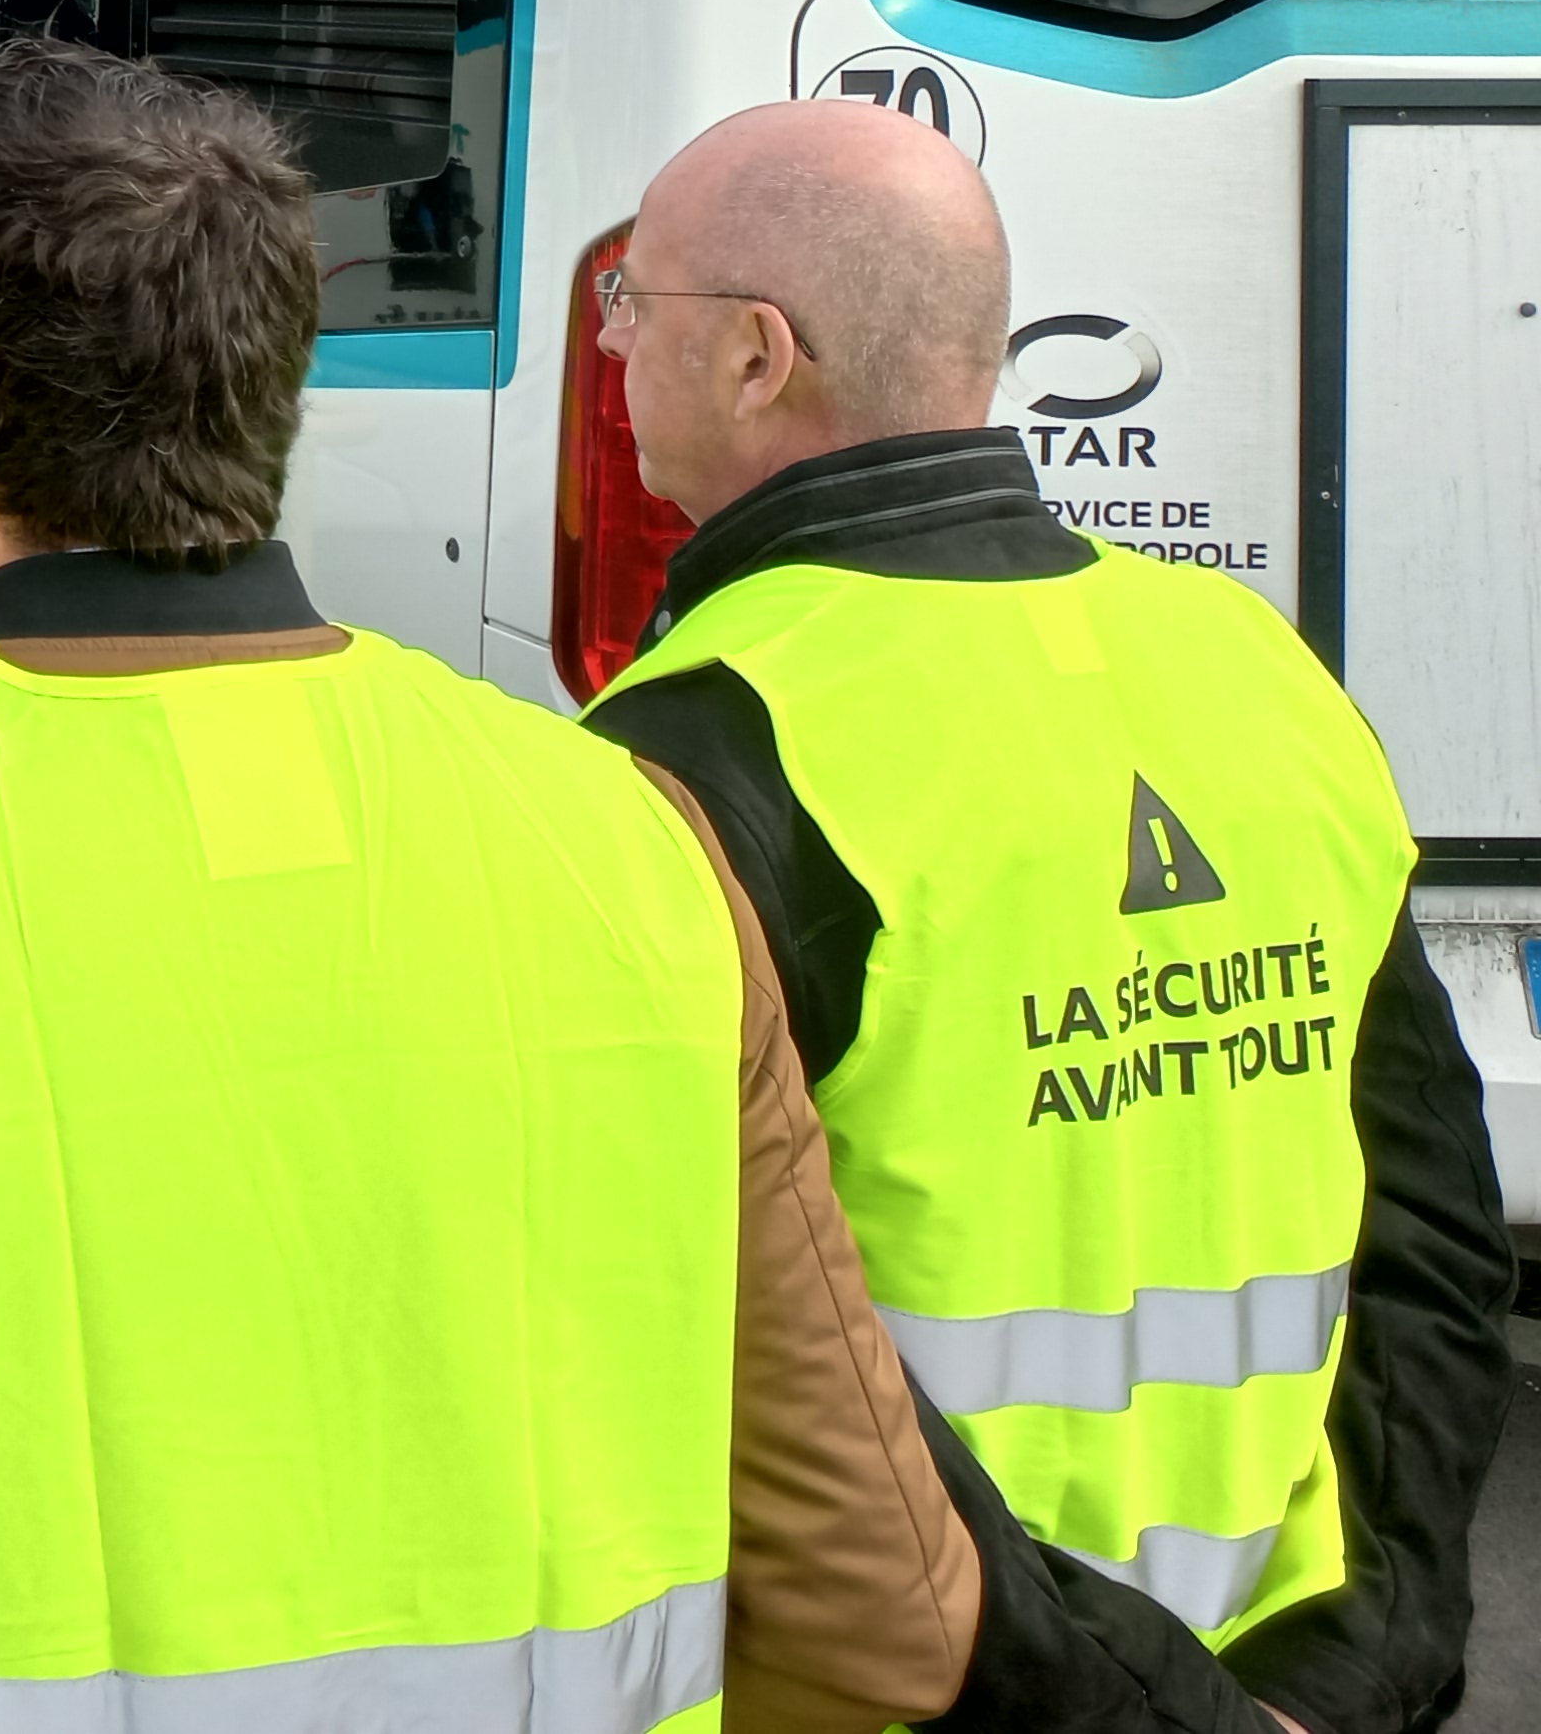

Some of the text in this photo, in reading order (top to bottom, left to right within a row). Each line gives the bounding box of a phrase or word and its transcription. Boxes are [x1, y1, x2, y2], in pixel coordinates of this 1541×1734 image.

[1028, 426, 1157, 468] TAR
[1041, 501, 1210, 528] RVICE DE
[1023, 923, 1330, 1050] LA SÉCURITÉ
[1027, 1016, 1336, 1128] AVANT TOUT
